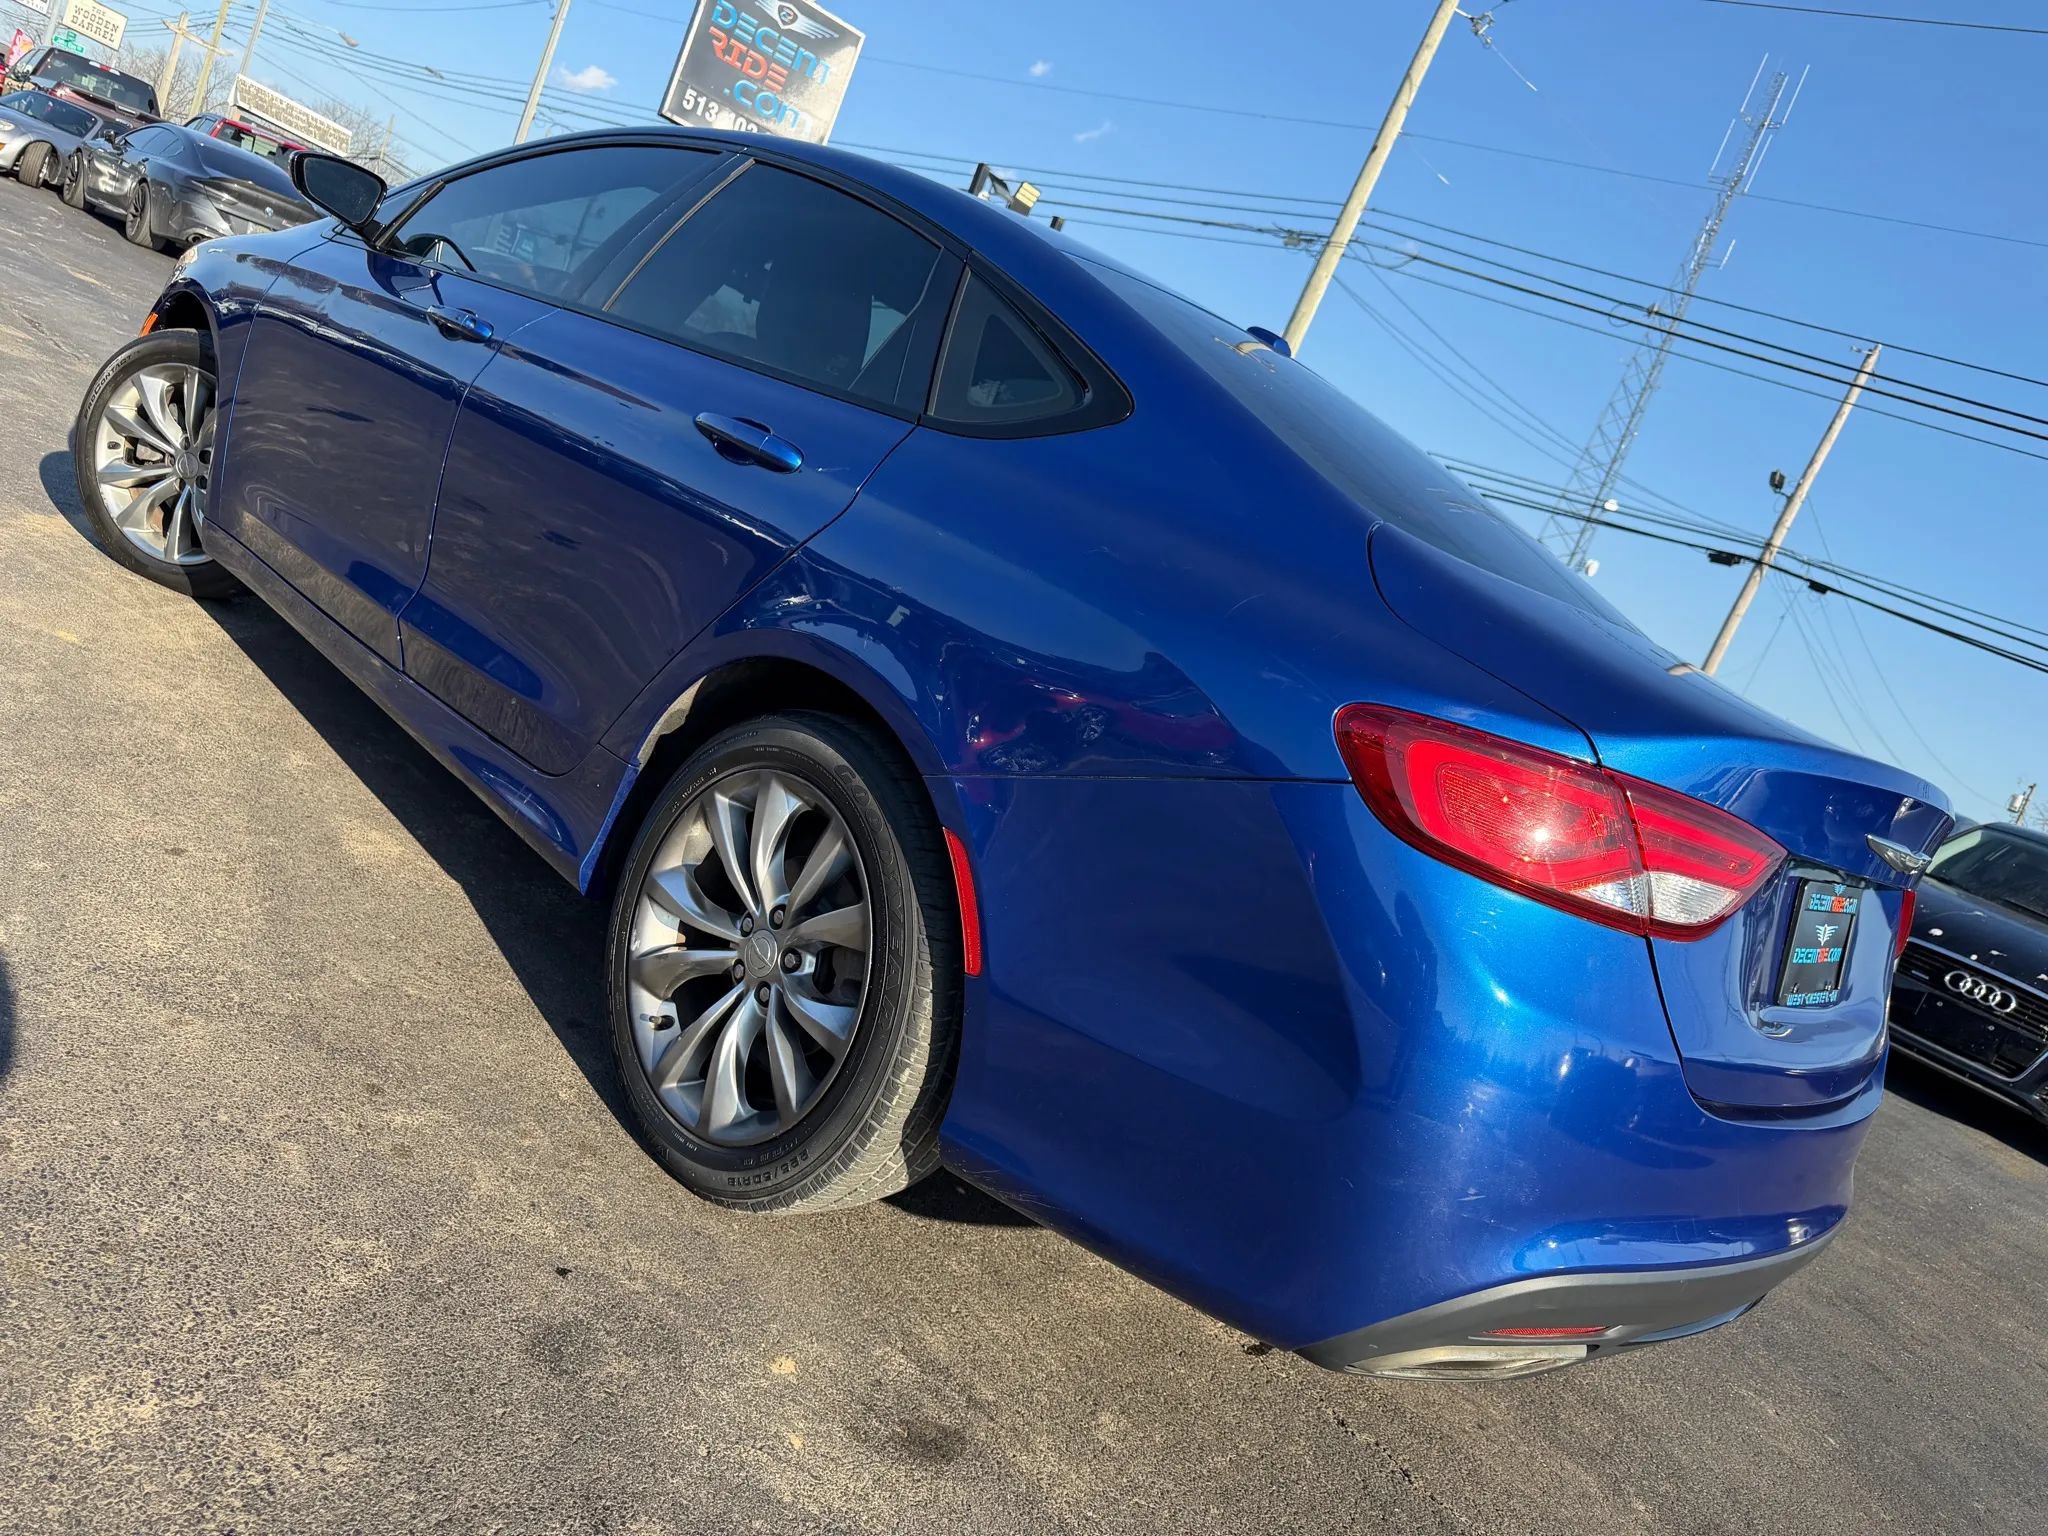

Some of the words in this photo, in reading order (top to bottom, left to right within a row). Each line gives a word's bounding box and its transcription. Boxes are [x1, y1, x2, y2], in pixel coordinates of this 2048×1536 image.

[71, 14, 115, 43] BARREL
[74, 5, 119, 33] WOODEN
[708, 26, 788, 93] RIDE
[682, 88, 719, 122] 513
